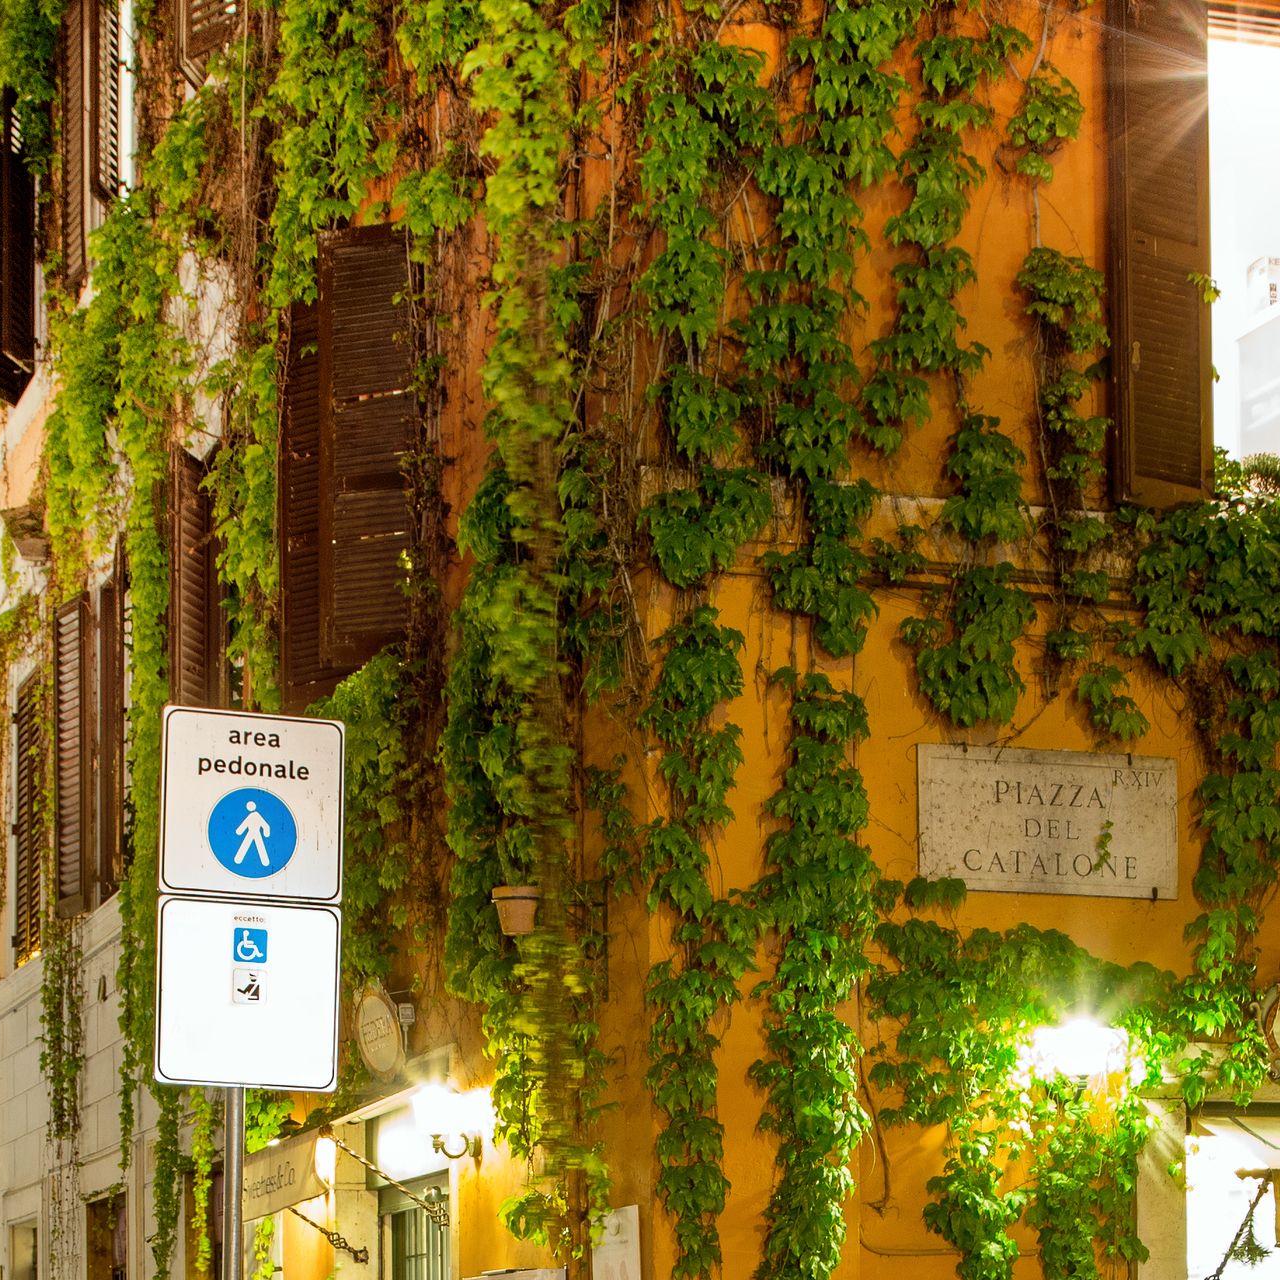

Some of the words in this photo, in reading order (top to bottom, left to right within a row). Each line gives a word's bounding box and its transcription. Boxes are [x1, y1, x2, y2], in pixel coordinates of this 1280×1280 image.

[228, 729, 281, 749] area
[198, 755, 310, 781] pedonale
[993, 779, 1107, 810] PIAZZA
[1023, 817, 1081, 841] DEL
[962, 848, 1138, 881] CATALONE
[233, 915, 264, 923] eccetto
